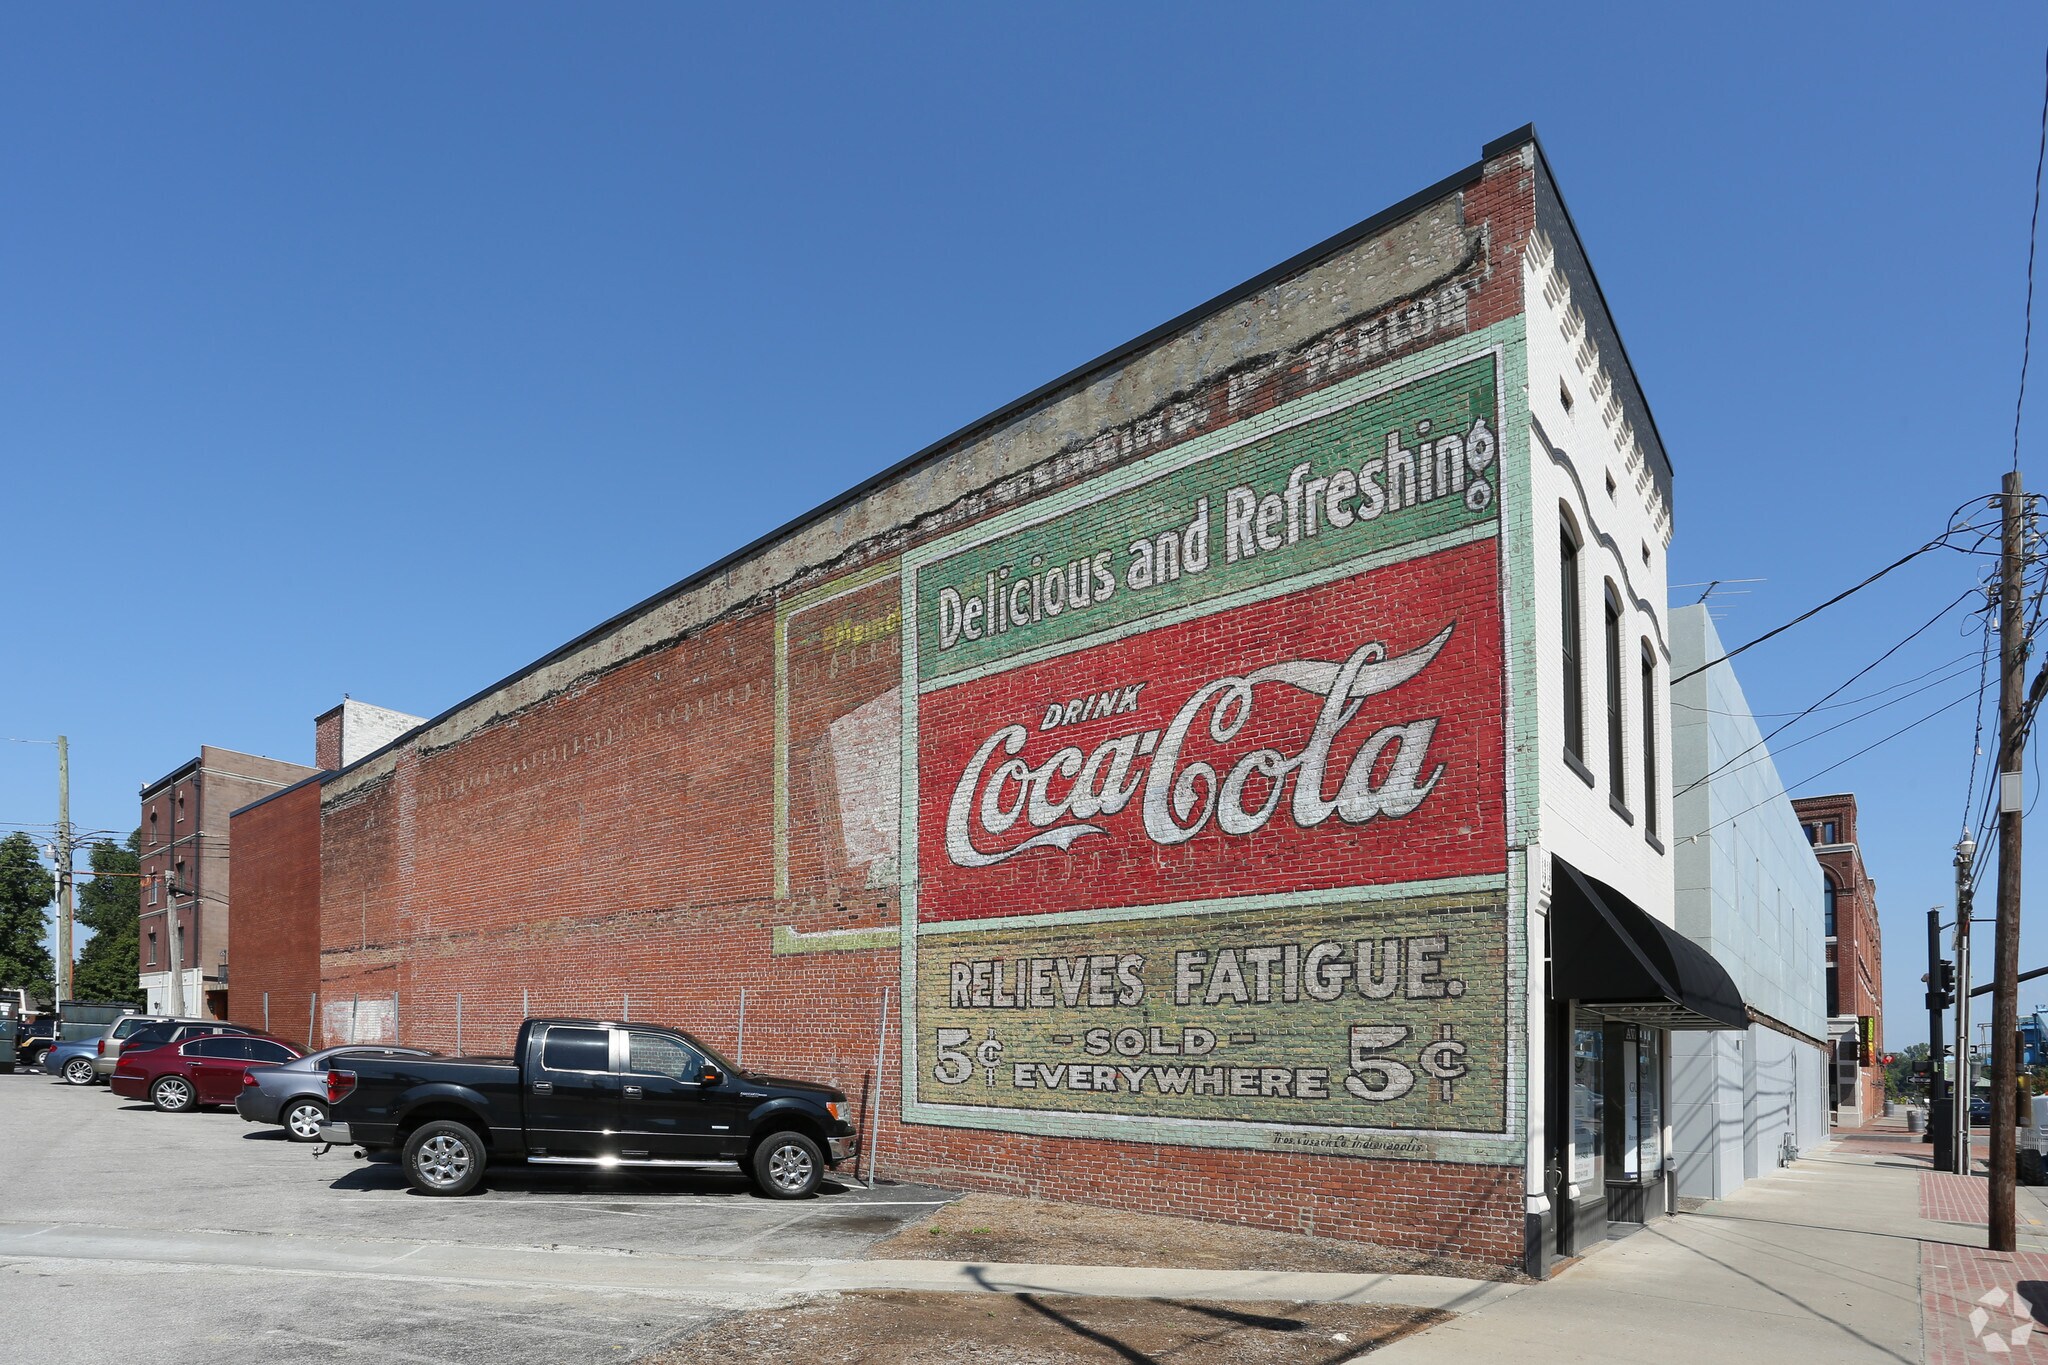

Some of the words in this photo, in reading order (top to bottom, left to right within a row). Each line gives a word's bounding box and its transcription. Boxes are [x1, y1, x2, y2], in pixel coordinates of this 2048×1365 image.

[938, 551, 1117, 652] Delicious
[1126, 497, 1210, 590] and
[1225, 415, 1496, 564] Refreshing
[1041, 682, 1149, 732] DRINK
[949, 952, 1147, 1009] RELIEVES
[1174, 936, 1468, 1006] FATIGUE.
[1084, 1026, 1218, 1057] SOLD
[1012, 1061, 1332, 1100] EVERYWHERE
